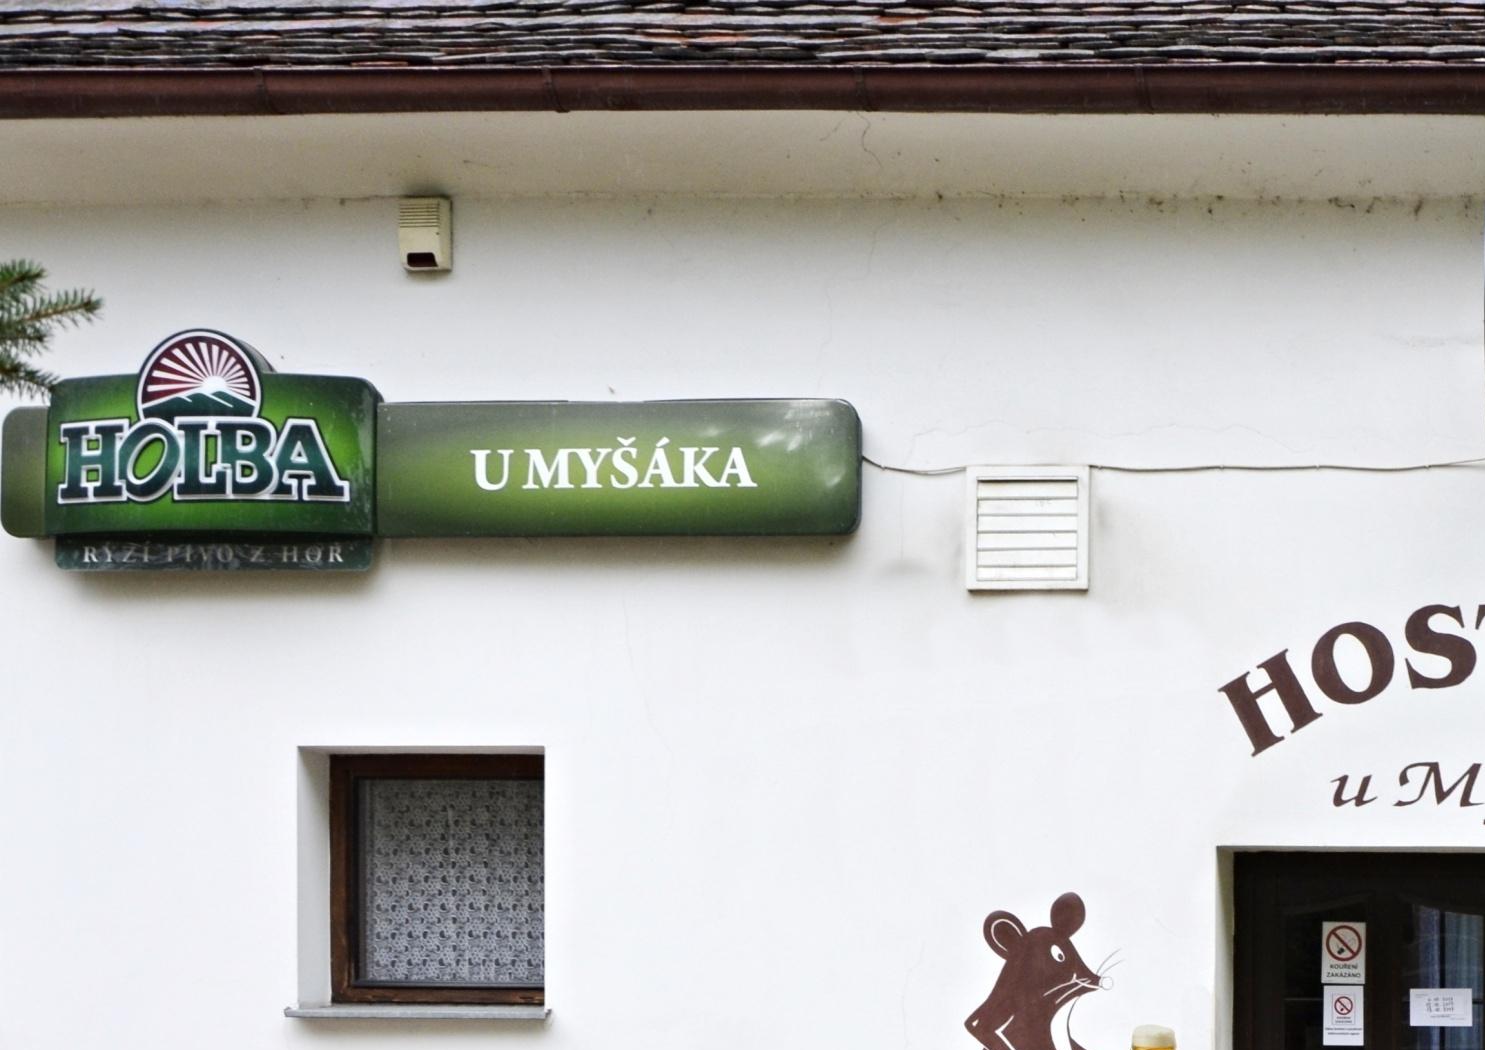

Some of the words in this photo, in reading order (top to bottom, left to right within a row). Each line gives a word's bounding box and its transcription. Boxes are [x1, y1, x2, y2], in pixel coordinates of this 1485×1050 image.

[57, 415, 350, 504] HOLBA
[470, 450, 508, 490] U
[522, 437, 757, 489] MYŠÁKA
[282, 545, 344, 563] HOR
[1331, 774, 1377, 807] u
